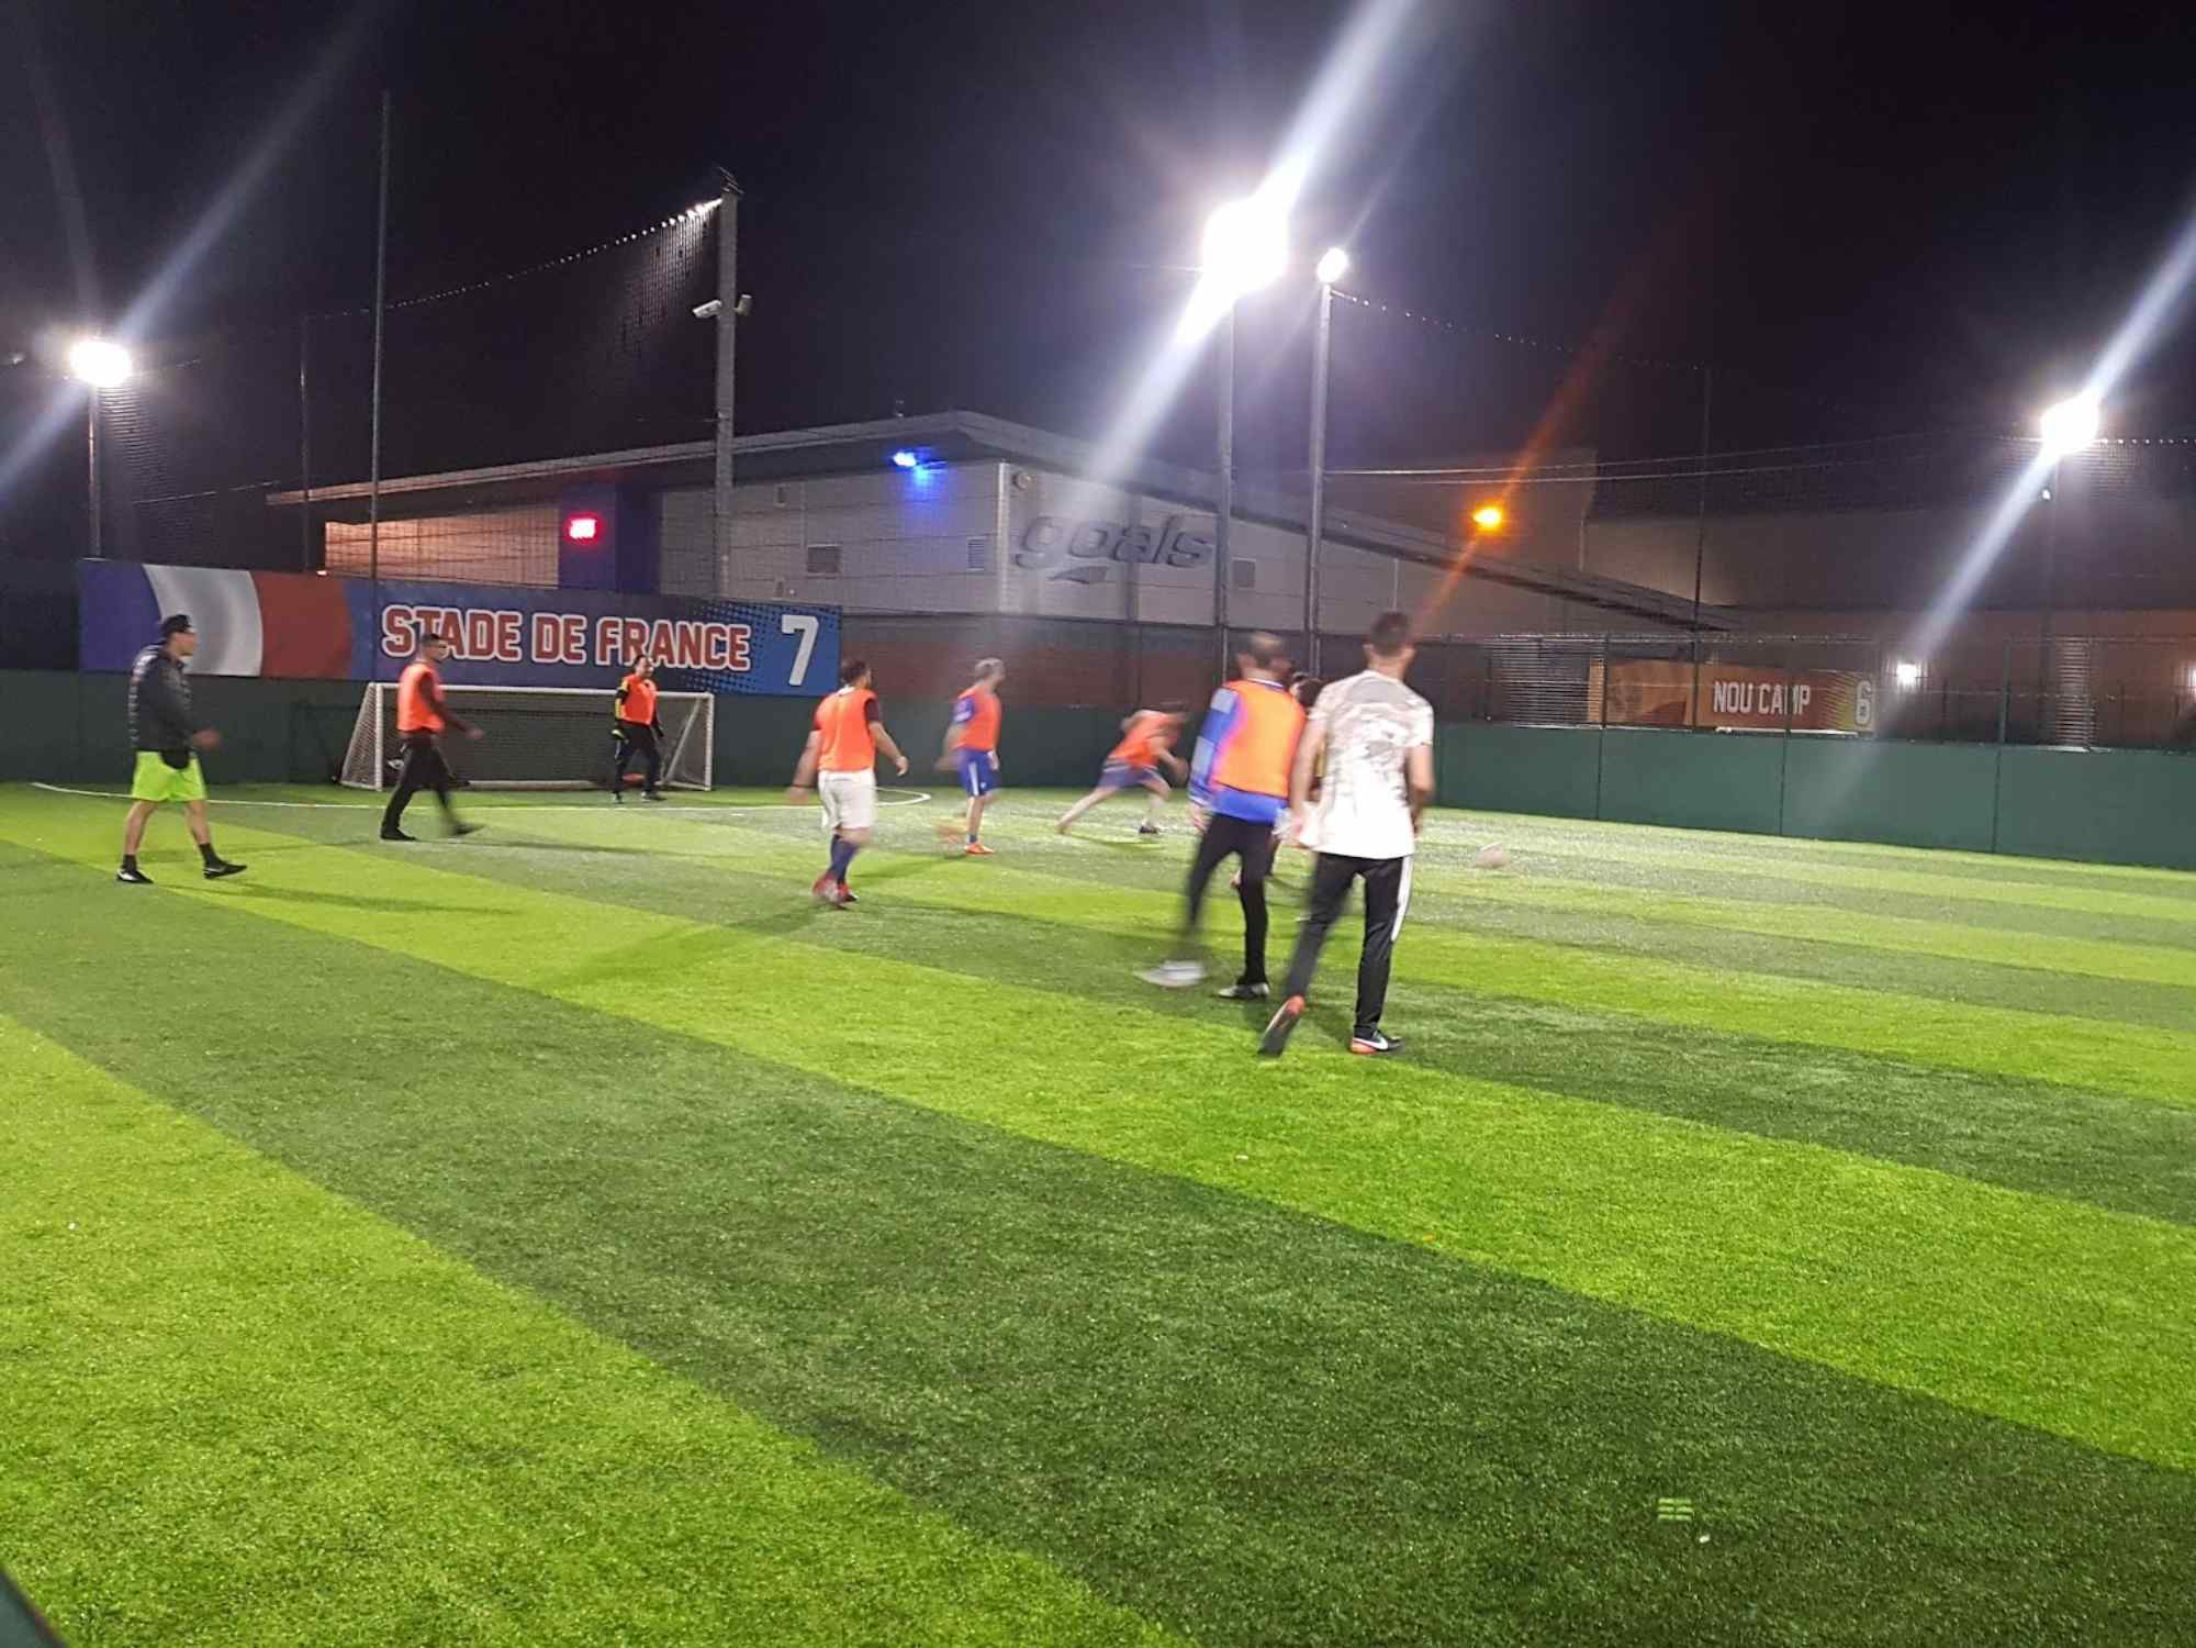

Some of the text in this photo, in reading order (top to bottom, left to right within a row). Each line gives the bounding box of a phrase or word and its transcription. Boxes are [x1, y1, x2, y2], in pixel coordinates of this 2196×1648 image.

[1014, 515, 1214, 569] goals
[382, 605, 751, 672] STADE DE FRANCE
[781, 614, 819, 687] 7
[1713, 681, 1752, 713] NOU
[1856, 680, 1872, 725] 6
